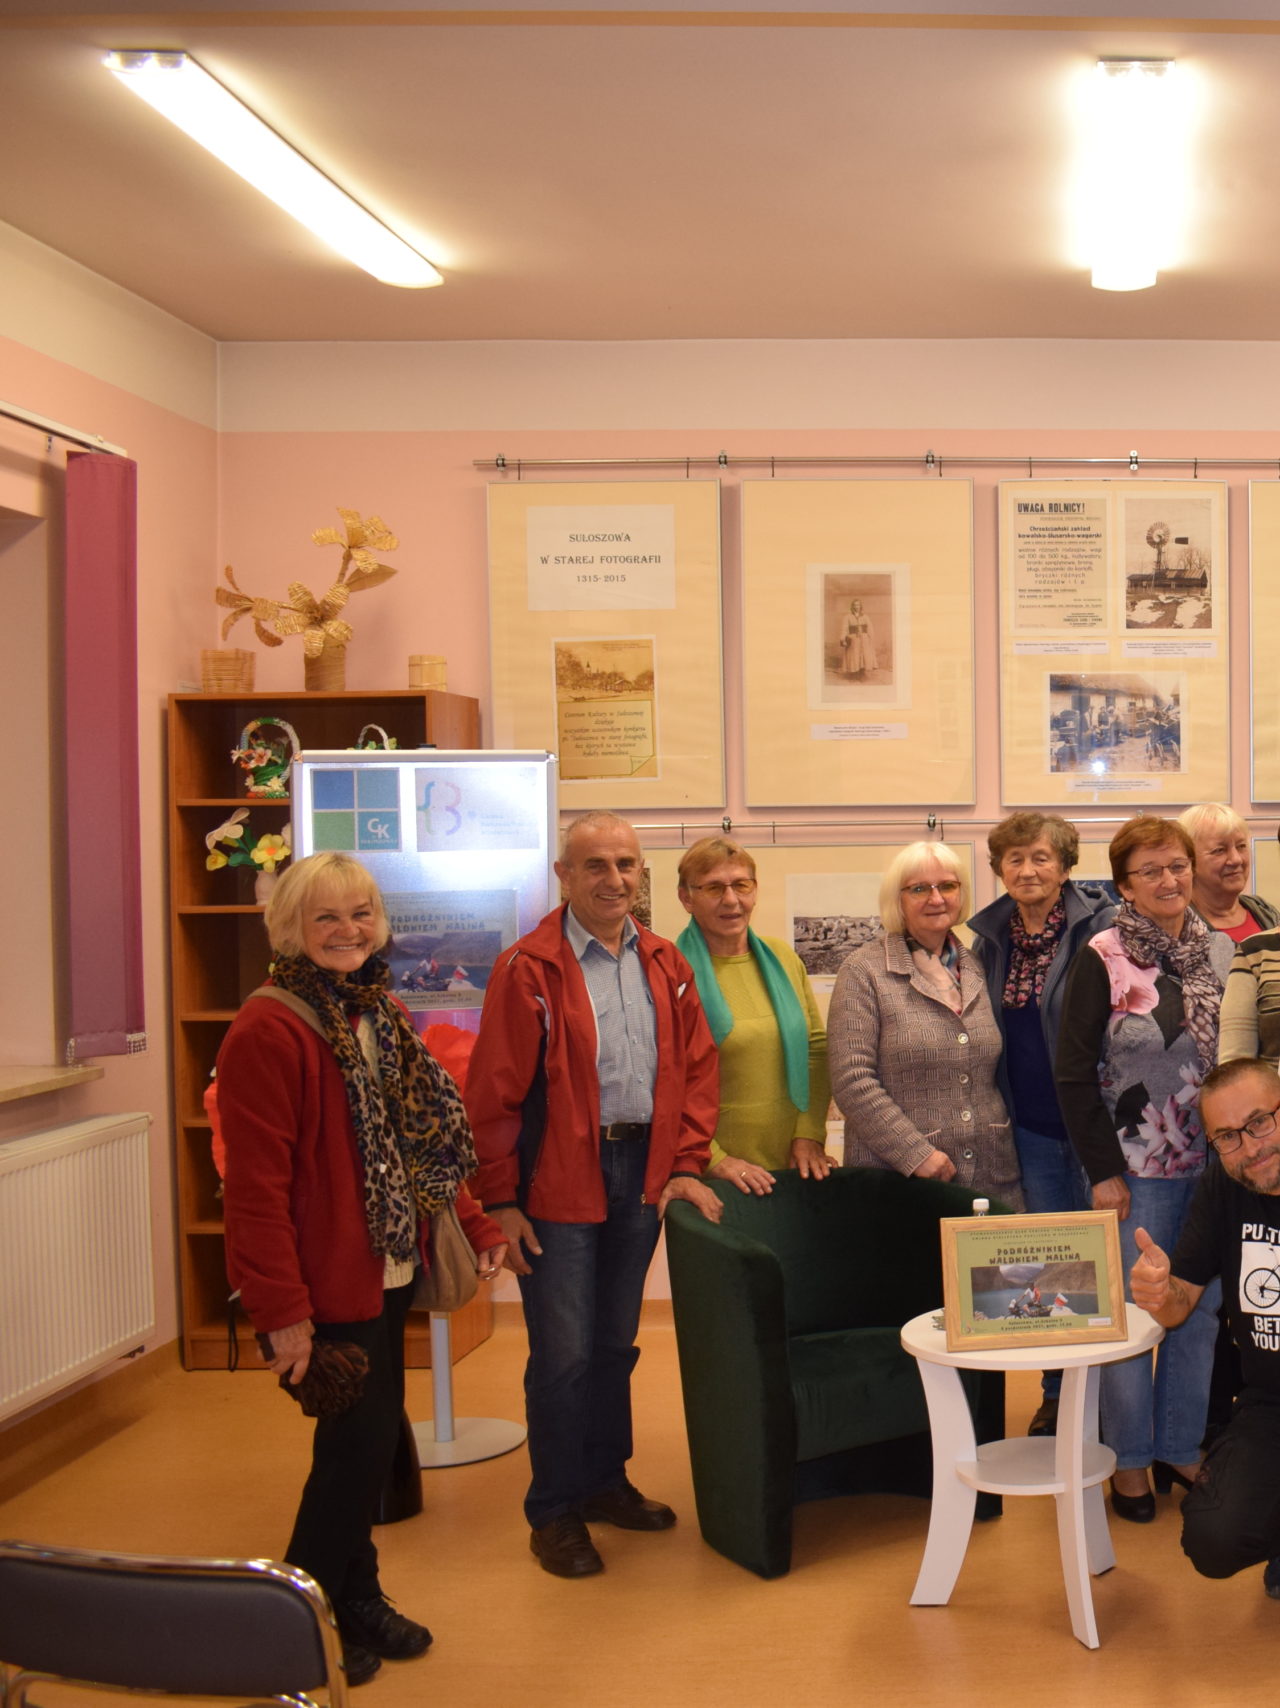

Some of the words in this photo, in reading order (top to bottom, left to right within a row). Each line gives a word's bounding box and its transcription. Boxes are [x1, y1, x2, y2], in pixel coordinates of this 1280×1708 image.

[1017, 503, 1045, 513] UWAGA
[1048, 503, 1086, 513] ROLNICY!
[568, 533, 632, 542] SUŁOSZOWA
[540, 555, 550, 564] W
[554, 556, 594, 565] STAREJ
[600, 555, 661, 564] FOTOGRAFII
[604, 574, 626, 582] 2015
[1241, 1223, 1270, 1241] PU
[989, 1255, 1039, 1265] WALDKIEM
